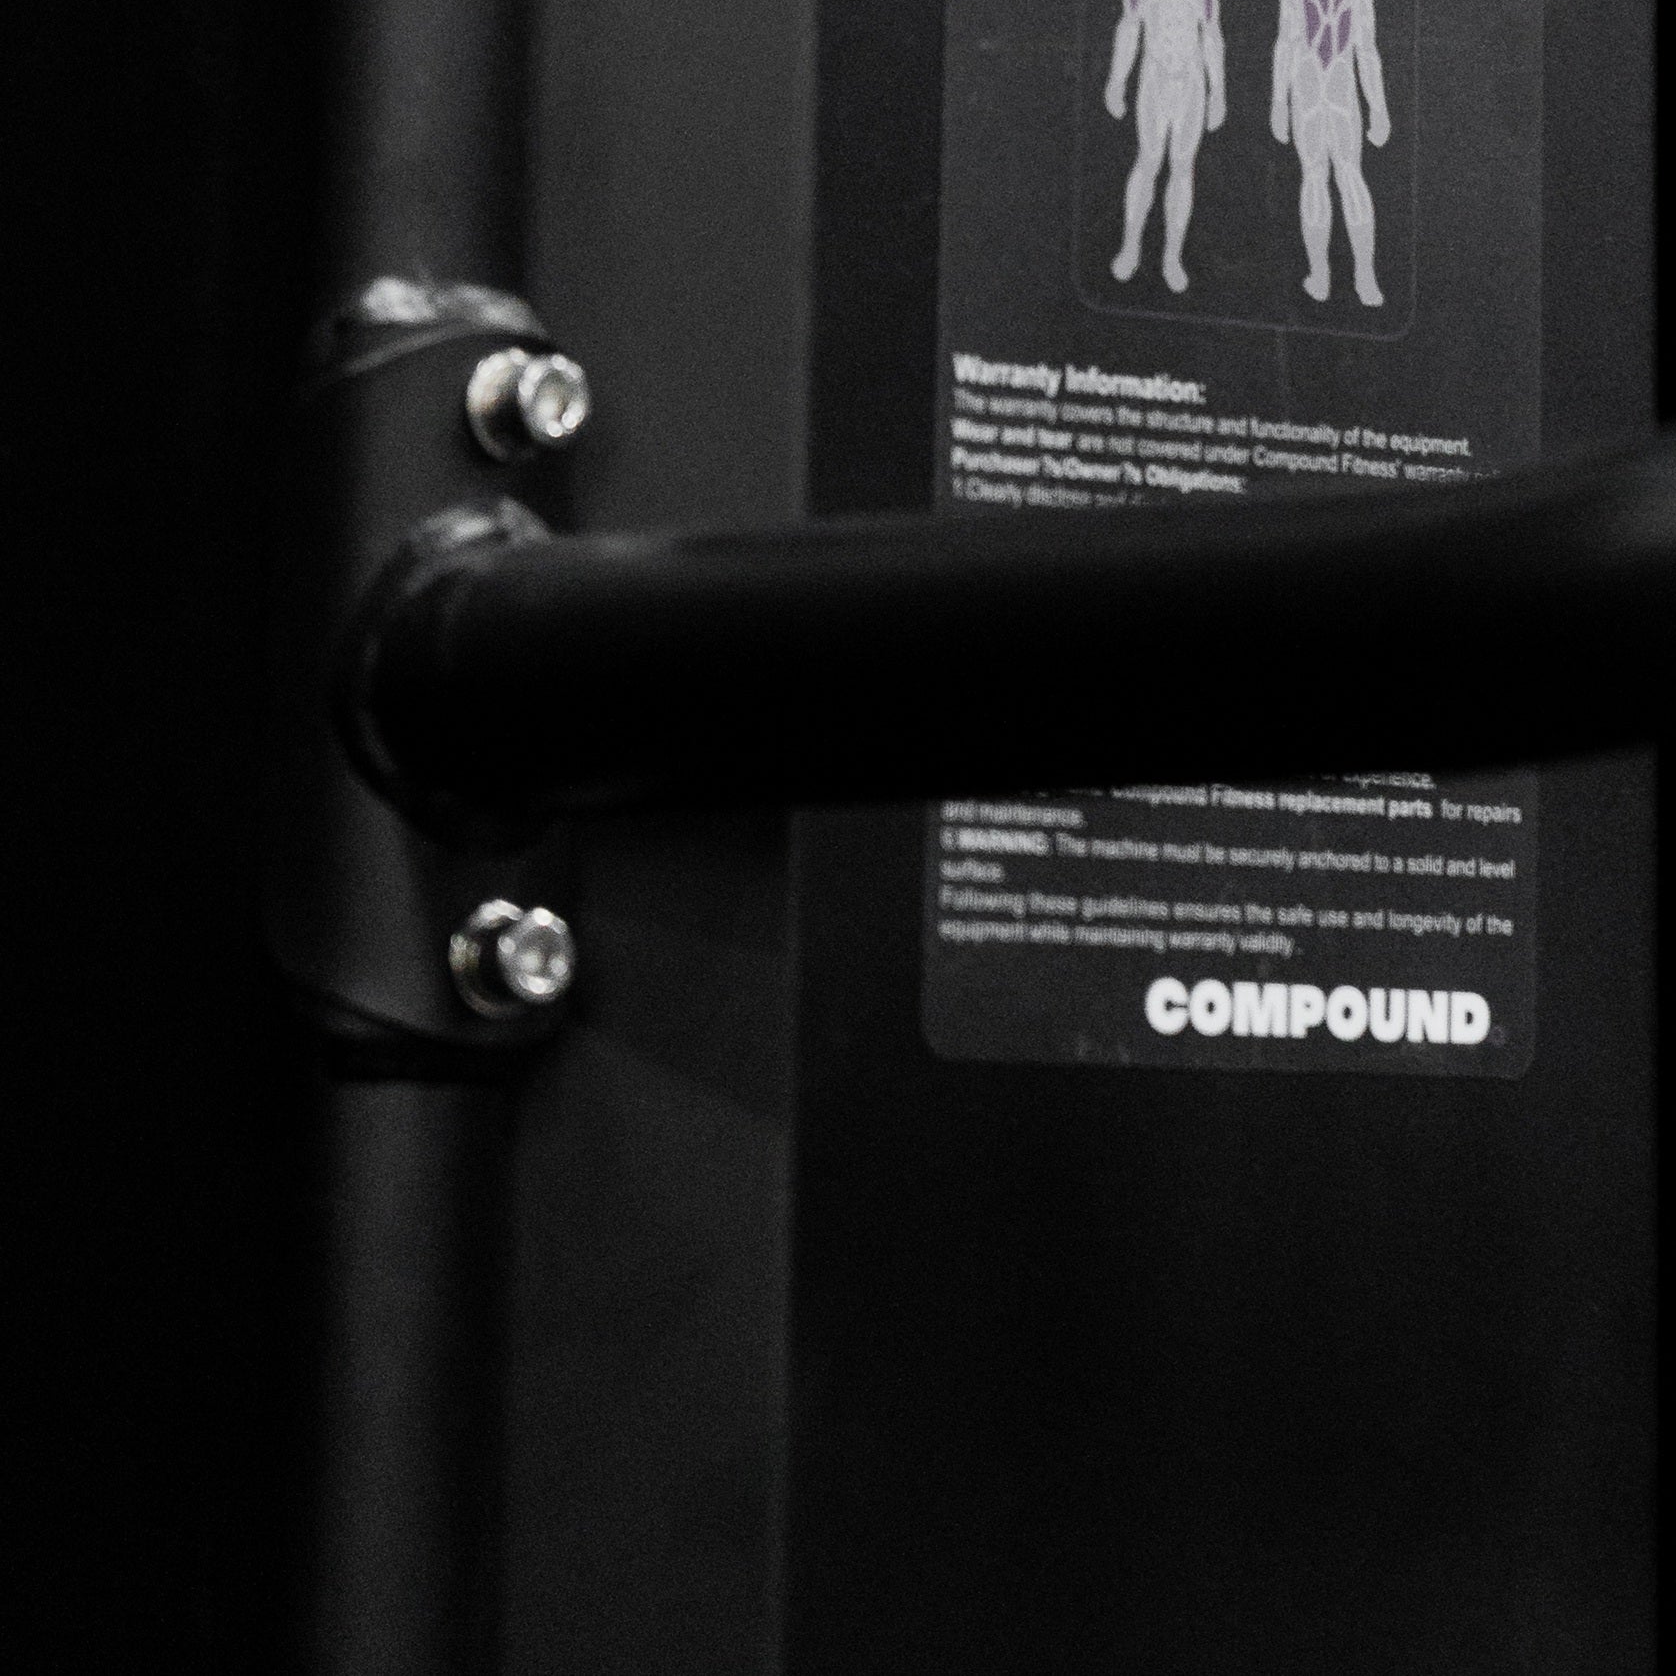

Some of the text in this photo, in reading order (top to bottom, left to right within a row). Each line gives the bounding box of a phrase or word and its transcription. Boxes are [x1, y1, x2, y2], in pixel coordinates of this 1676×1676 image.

[953, 354, 1207, 406] Warranty Information:
[1117, 406, 1142, 427] the
[1145, 410, 1214, 435] structure
[1217, 417, 1248, 437] and
[1250, 417, 1341, 450] functionality
[1343, 426, 1360, 447] of
[1362, 428, 1387, 450] the
[1203, 444, 1249, 466] under
[1252, 445, 1337, 475] Compound
[1211, 783, 1275, 810] Fitness
[1278, 789, 1386, 816] replacement
[1389, 798, 1434, 821] parts
[1440, 798, 1464, 820] for
[1466, 801, 1523, 826] repairs
[1228, 846, 1295, 874] securely
[1298, 849, 1372, 874] anchored
[1374, 853, 1391, 874] to
[1393, 857, 1405, 875] a
[1407, 854, 1444, 877] solid
[1447, 857, 1476, 878] and
[1479, 857, 1517, 880] level
[1244, 902, 1272, 926] the
[1276, 903, 1314, 927] safe
[1318, 908, 1348, 928] use
[1352, 907, 1384, 930] and
[1387, 909, 1462, 937] longevity
[1465, 913, 1485, 935] of
[1486, 914, 1515, 937] the
[1144, 976, 1492, 1045] COMPOUND
